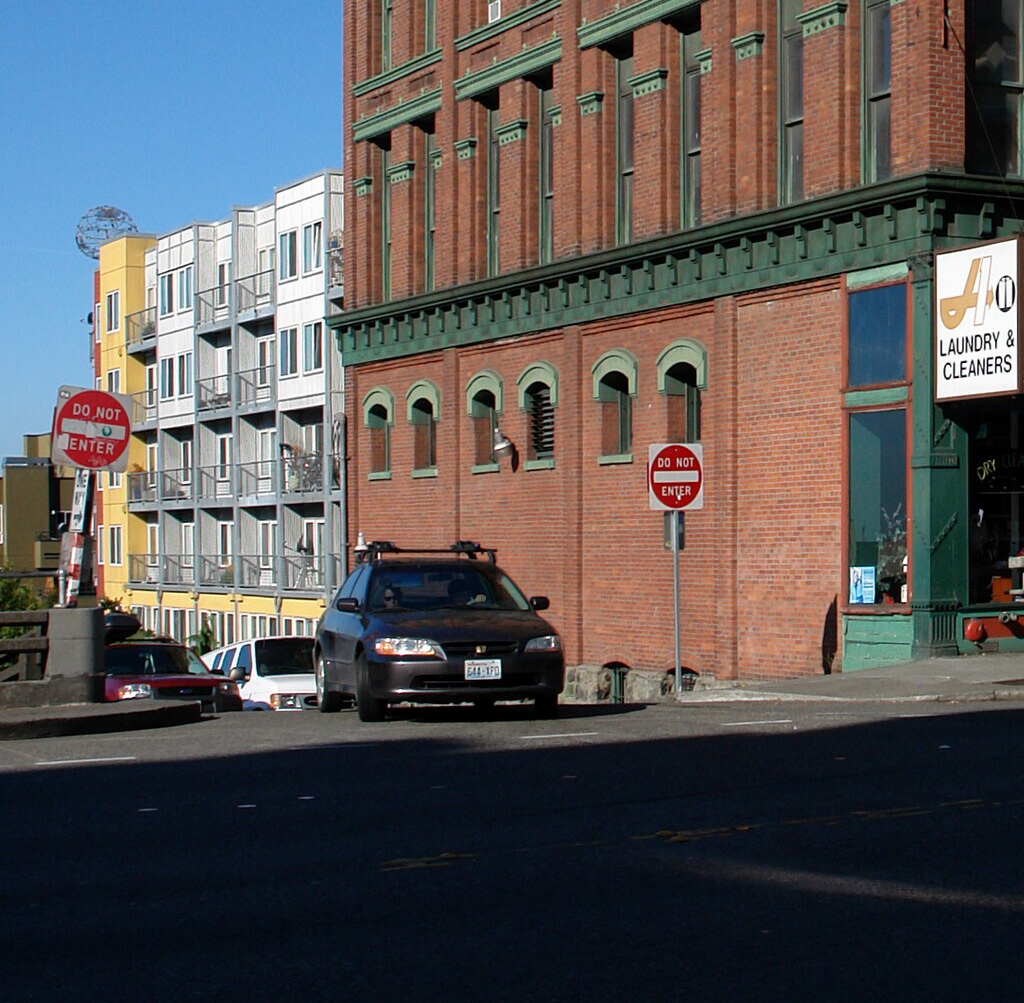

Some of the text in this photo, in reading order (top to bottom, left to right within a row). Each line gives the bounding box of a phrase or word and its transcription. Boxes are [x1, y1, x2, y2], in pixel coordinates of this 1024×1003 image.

[940, 329, 1015, 357] LAUNDRY &
[943, 354, 1012, 380] CLEANERS
[72, 403, 121, 421] DO NOT
[69, 437, 115, 455] ENTER
[657, 457, 695, 468] DO NOT
[976, 459, 996, 481] DRY
[661, 485, 692, 497] ENTER
